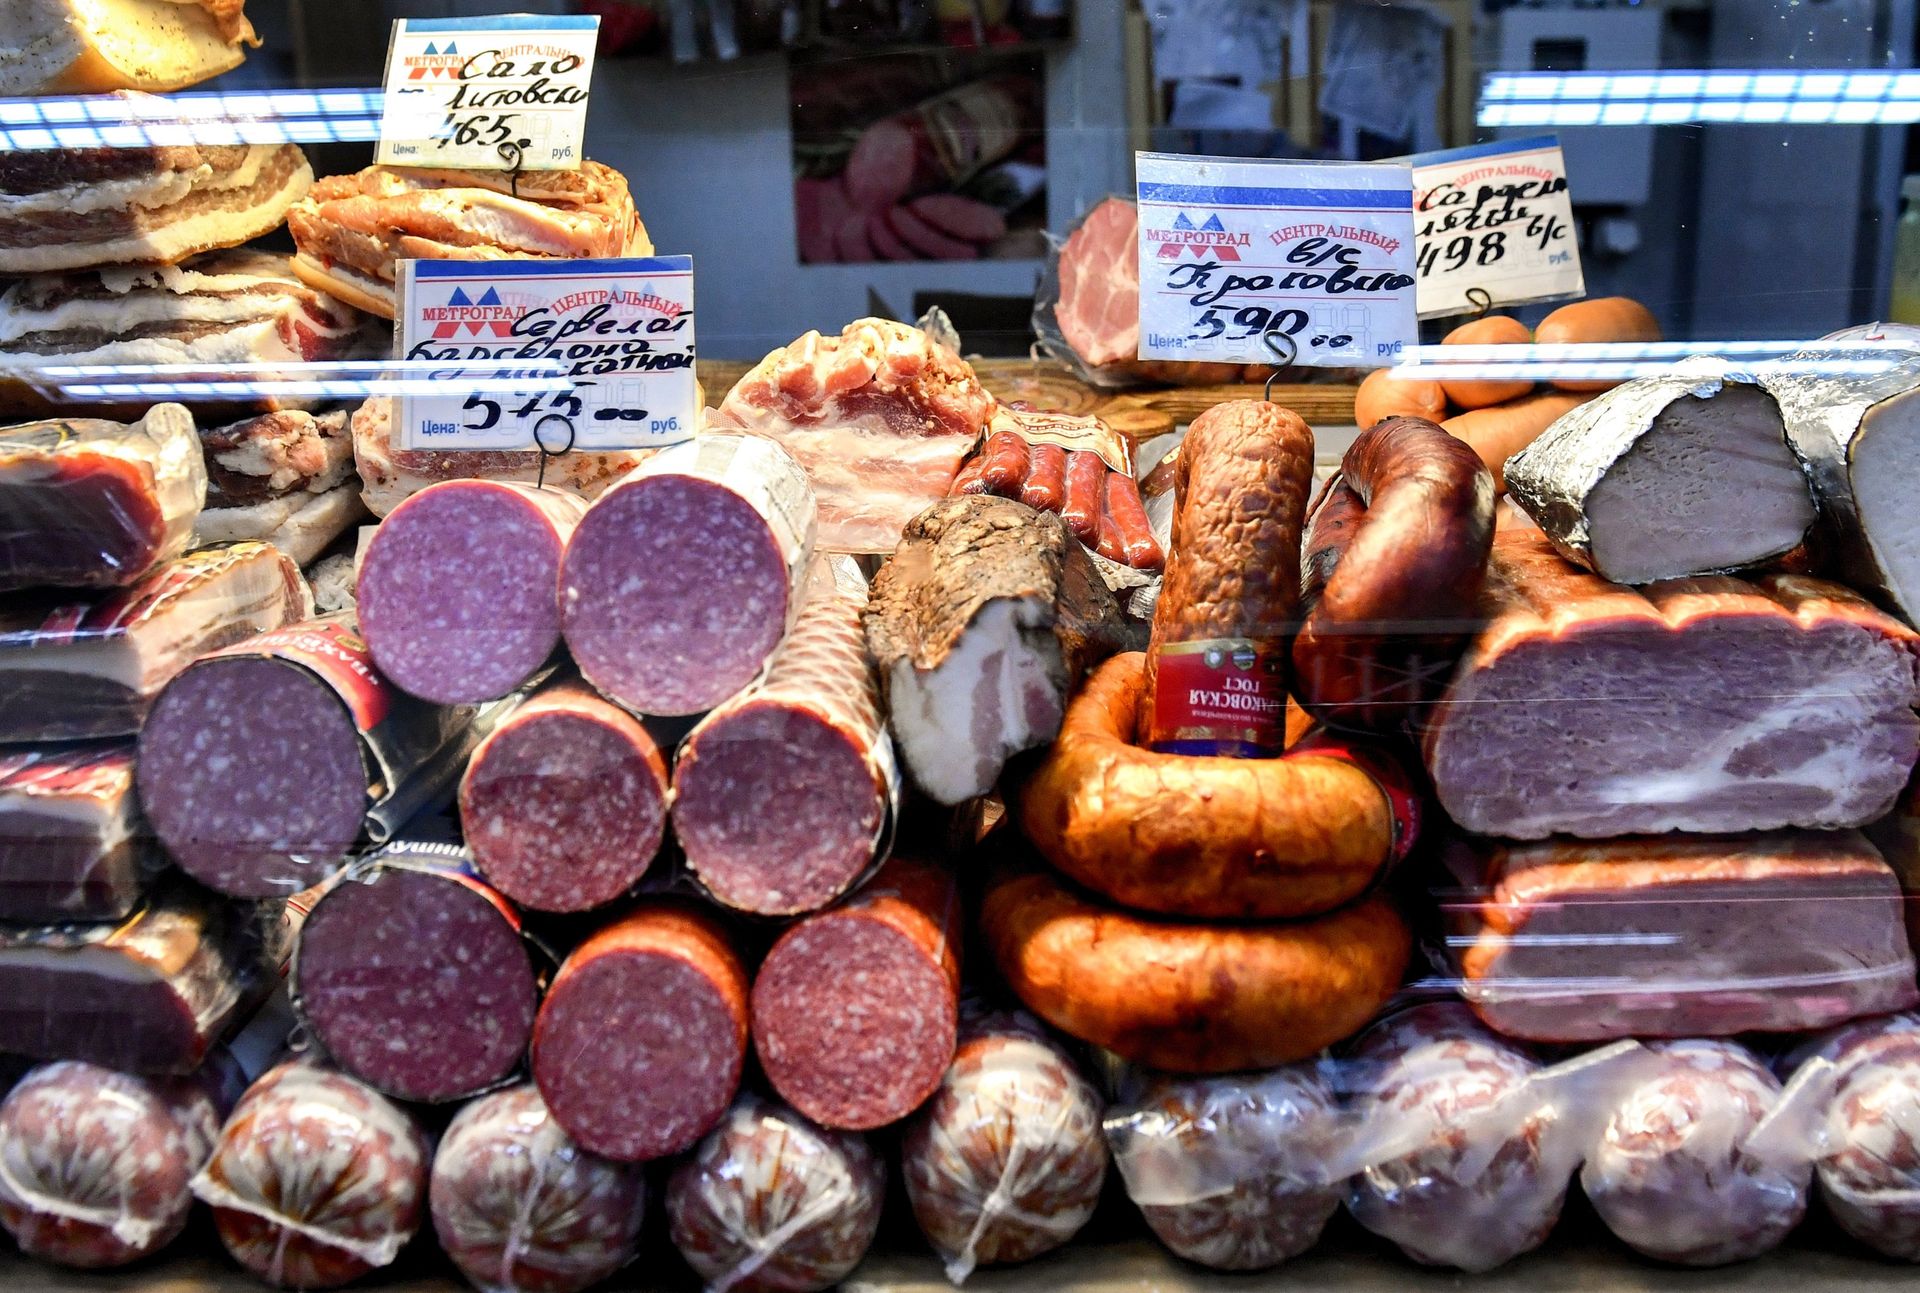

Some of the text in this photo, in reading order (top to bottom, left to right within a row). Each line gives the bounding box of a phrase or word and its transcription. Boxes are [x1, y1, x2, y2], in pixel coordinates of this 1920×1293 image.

[393, 144, 418, 154] Цена:
[552, 148, 574, 158] руб.
[1147, 228, 1251, 247] МЕТРОГРАД
[1269, 224, 1400, 255] ЦЕНТРАЛЬНЫЙ
[1416, 232, 1507, 277] 498
[551, 289, 686, 320] ЦЕНТРАЛЬНЫЙ
[422, 306, 528, 321] МЕТРОГРАД
[1148, 333, 1187, 349] Цена:
[422, 420, 460, 435] Цена:
[651, 420, 682, 434] руб.
[1222, 676, 1260, 694] ГОСТ
